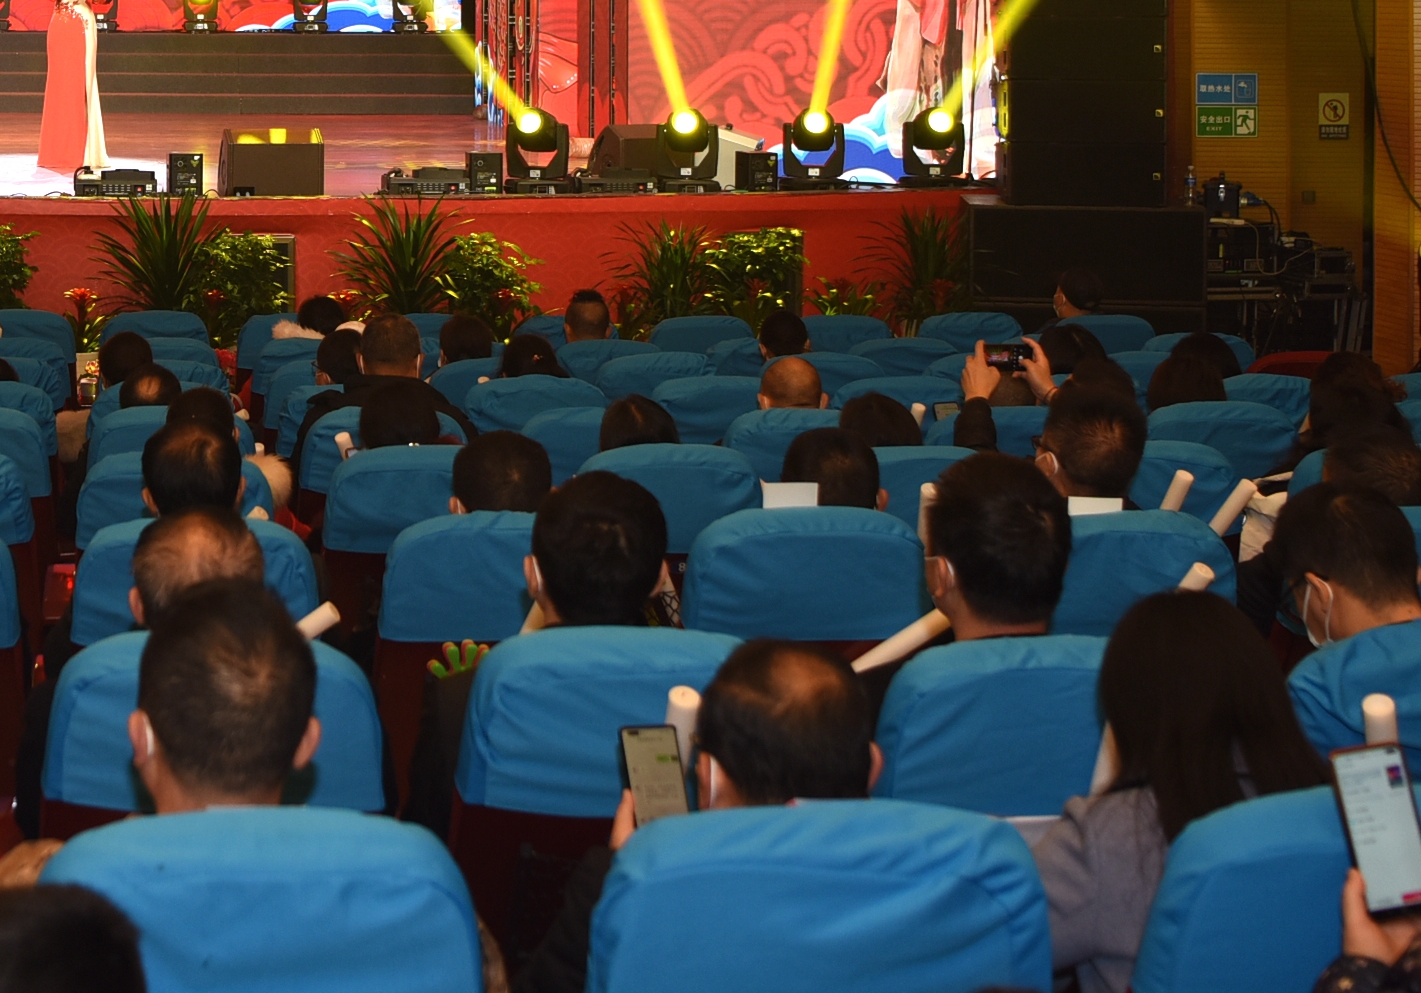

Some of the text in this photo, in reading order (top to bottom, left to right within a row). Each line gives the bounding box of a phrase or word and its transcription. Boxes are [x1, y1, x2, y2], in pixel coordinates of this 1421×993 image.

[1199, 115, 1231, 124] 安全出口
[678, 562, 686, 572] 8
